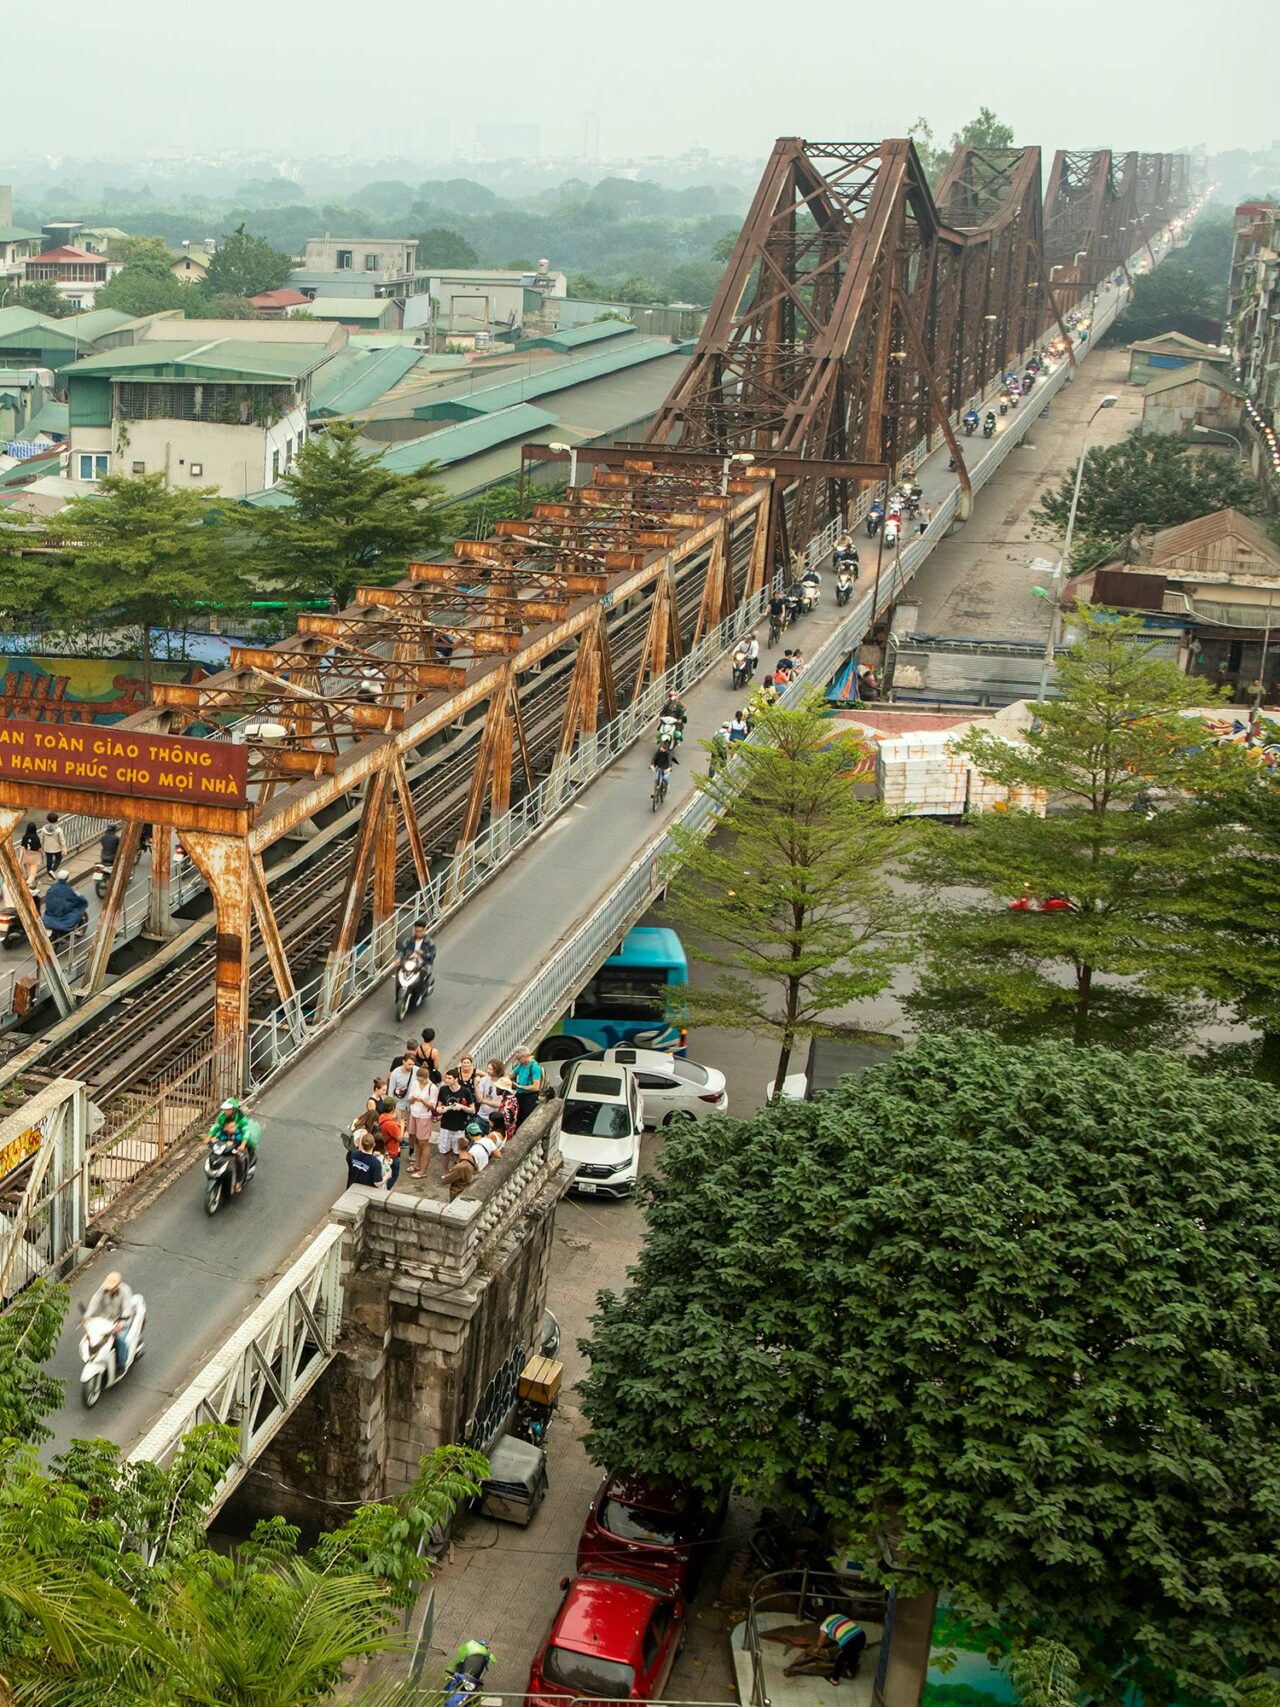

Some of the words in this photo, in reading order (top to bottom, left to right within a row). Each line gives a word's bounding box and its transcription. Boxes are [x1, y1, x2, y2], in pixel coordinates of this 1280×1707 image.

[0, 730, 24, 744] AN
[34, 732, 83, 751] TOÀN
[149, 744, 212, 766] THÔNG
[11, 754, 57, 773] HẠNH
[65, 758, 108, 778] PHÚC
[116, 768, 150, 783] CHO
[201, 774, 238, 794] NHÀ
